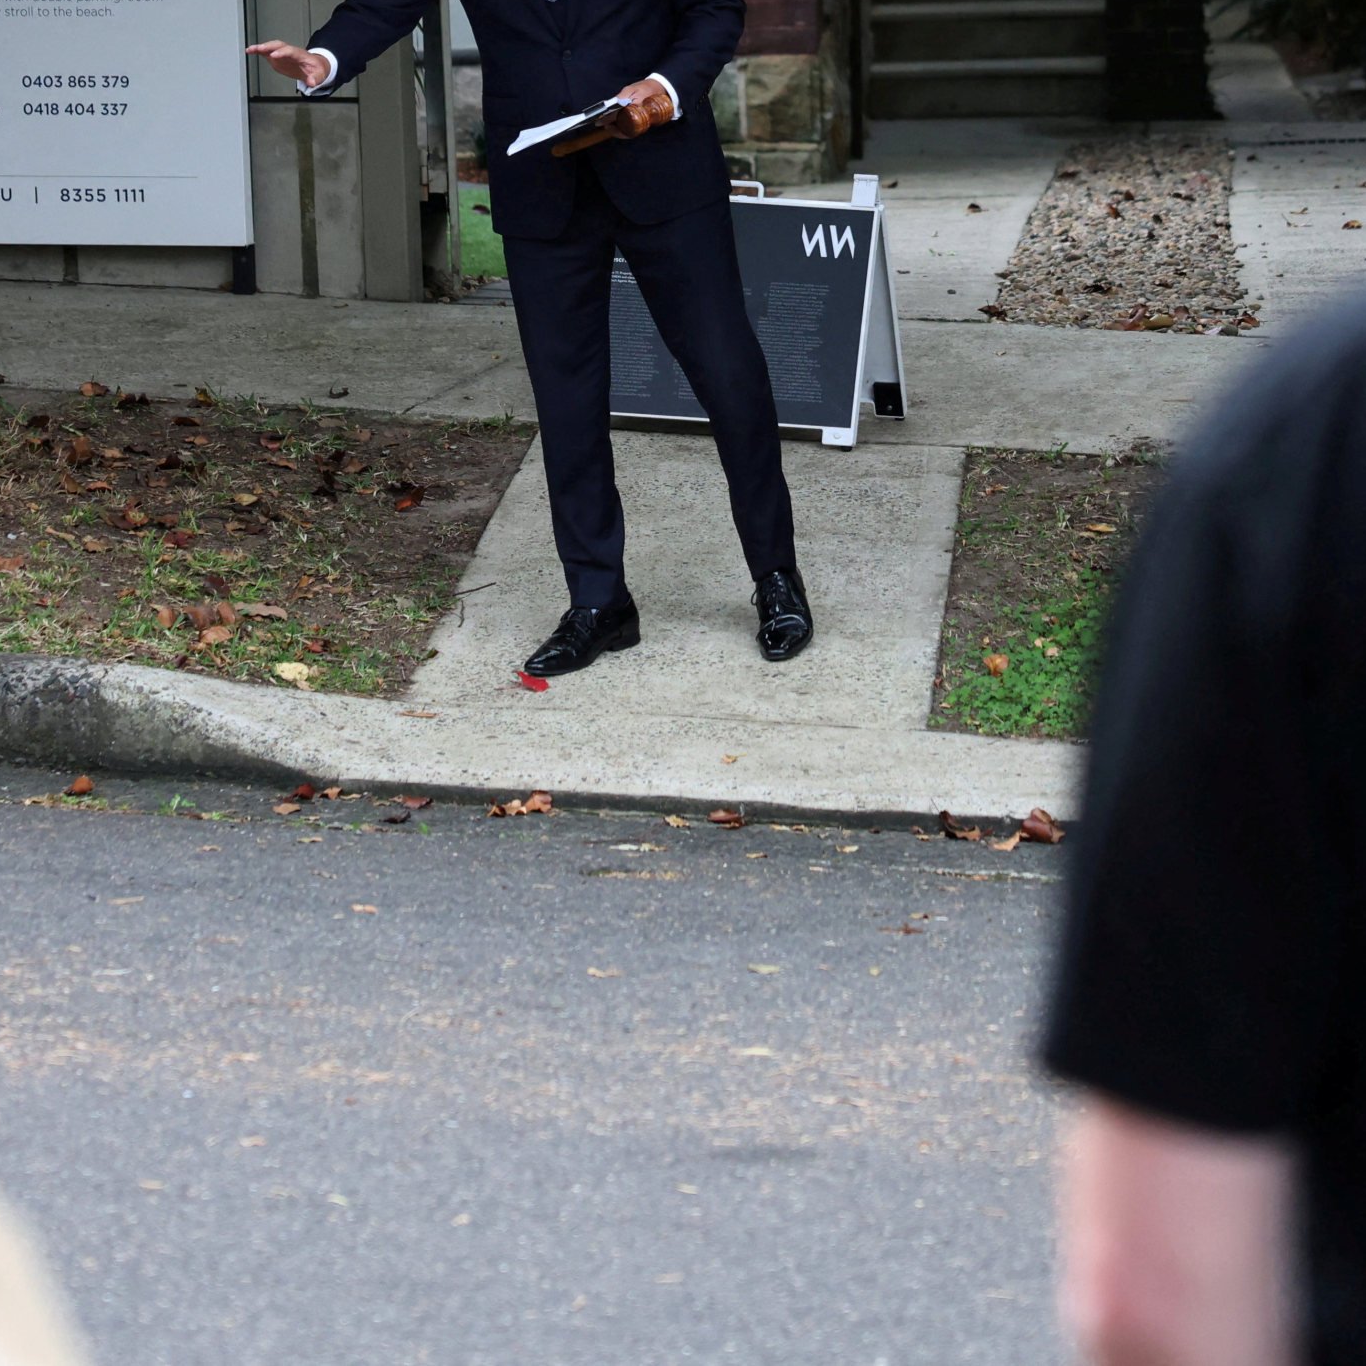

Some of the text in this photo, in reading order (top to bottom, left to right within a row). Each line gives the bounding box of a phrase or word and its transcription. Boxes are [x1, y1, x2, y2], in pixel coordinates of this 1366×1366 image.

[5, 6, 34, 17] stroll
[37, 7, 51, 17] to
[52, 6, 72, 17] the
[22, 75, 129, 88] 0403 865 379
[23, 103, 127, 116] 0418 404 337
[61, 188, 106, 202] 8355
[114, 189, 146, 202] 1111
